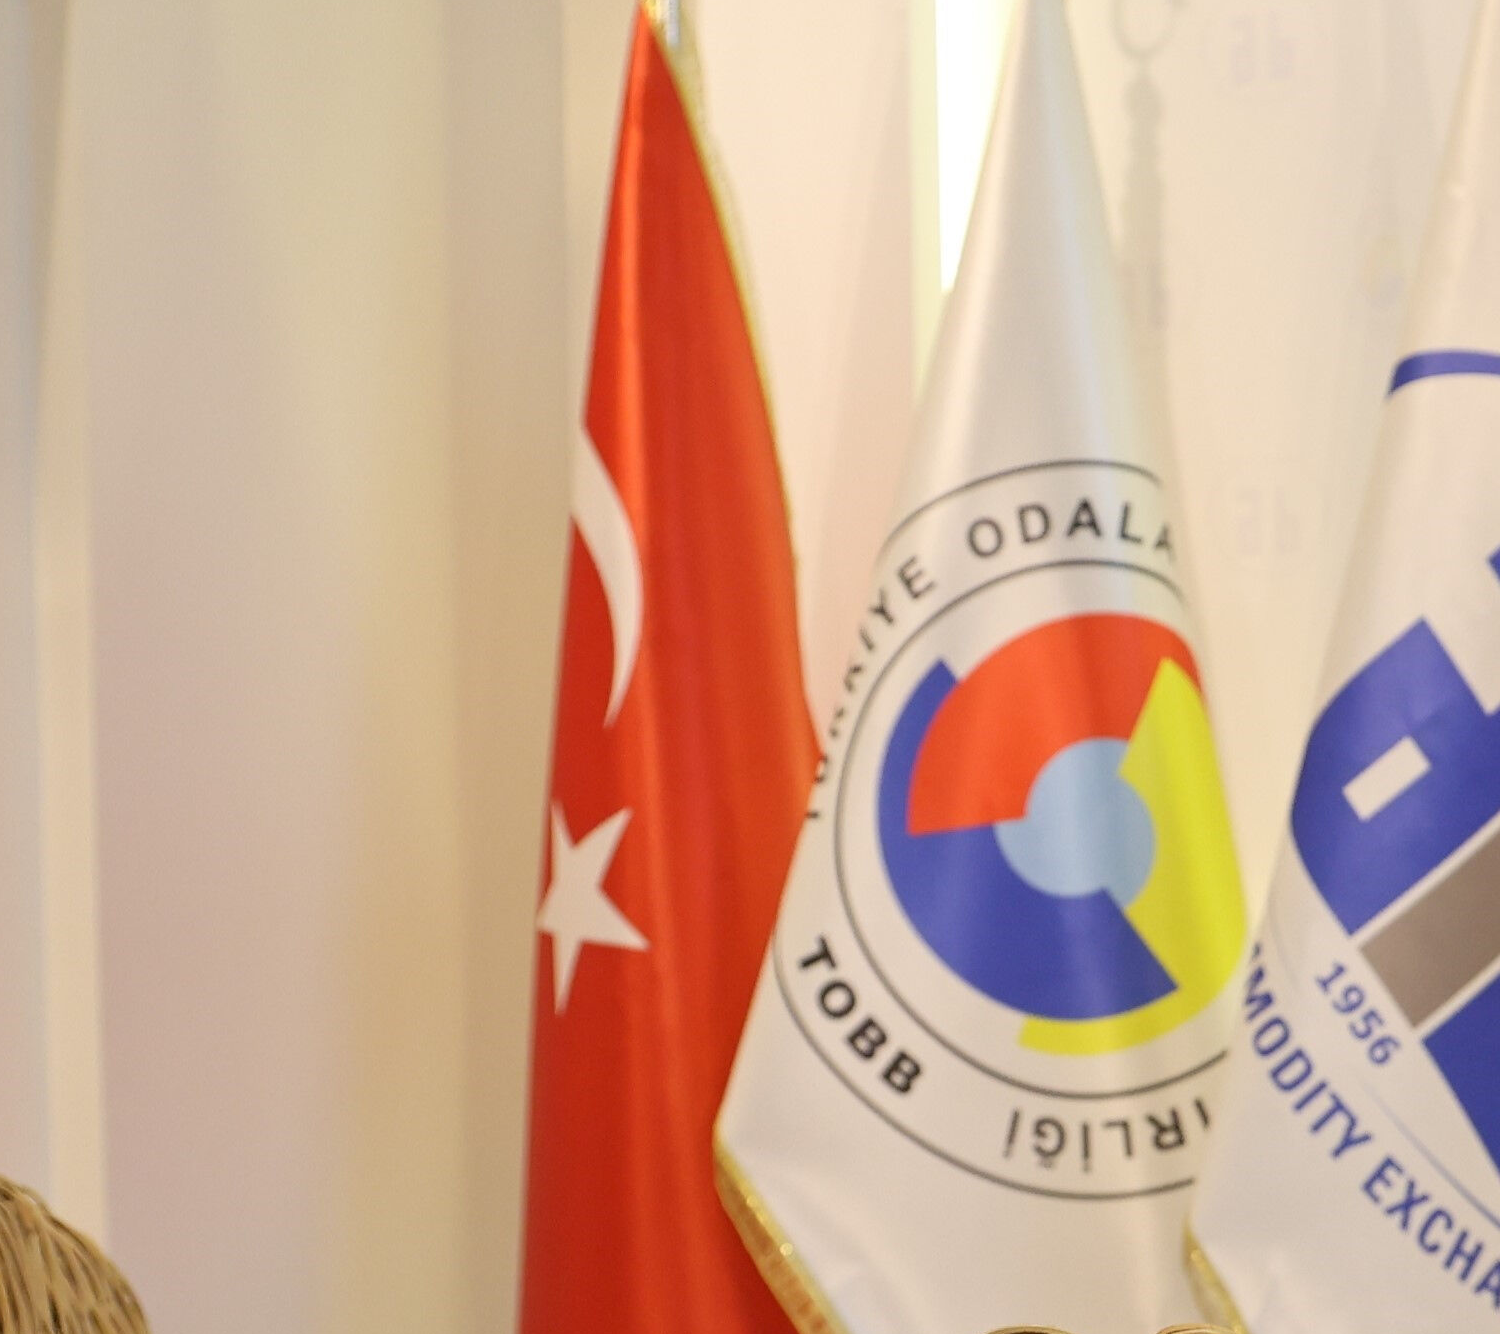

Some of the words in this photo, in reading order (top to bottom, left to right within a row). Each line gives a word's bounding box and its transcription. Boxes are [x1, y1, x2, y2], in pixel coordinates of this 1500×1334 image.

[796, 937, 923, 1094] TOBB
[1243, 944, 1372, 1159] MODITY
[1315, 960, 1403, 1068] 1956
